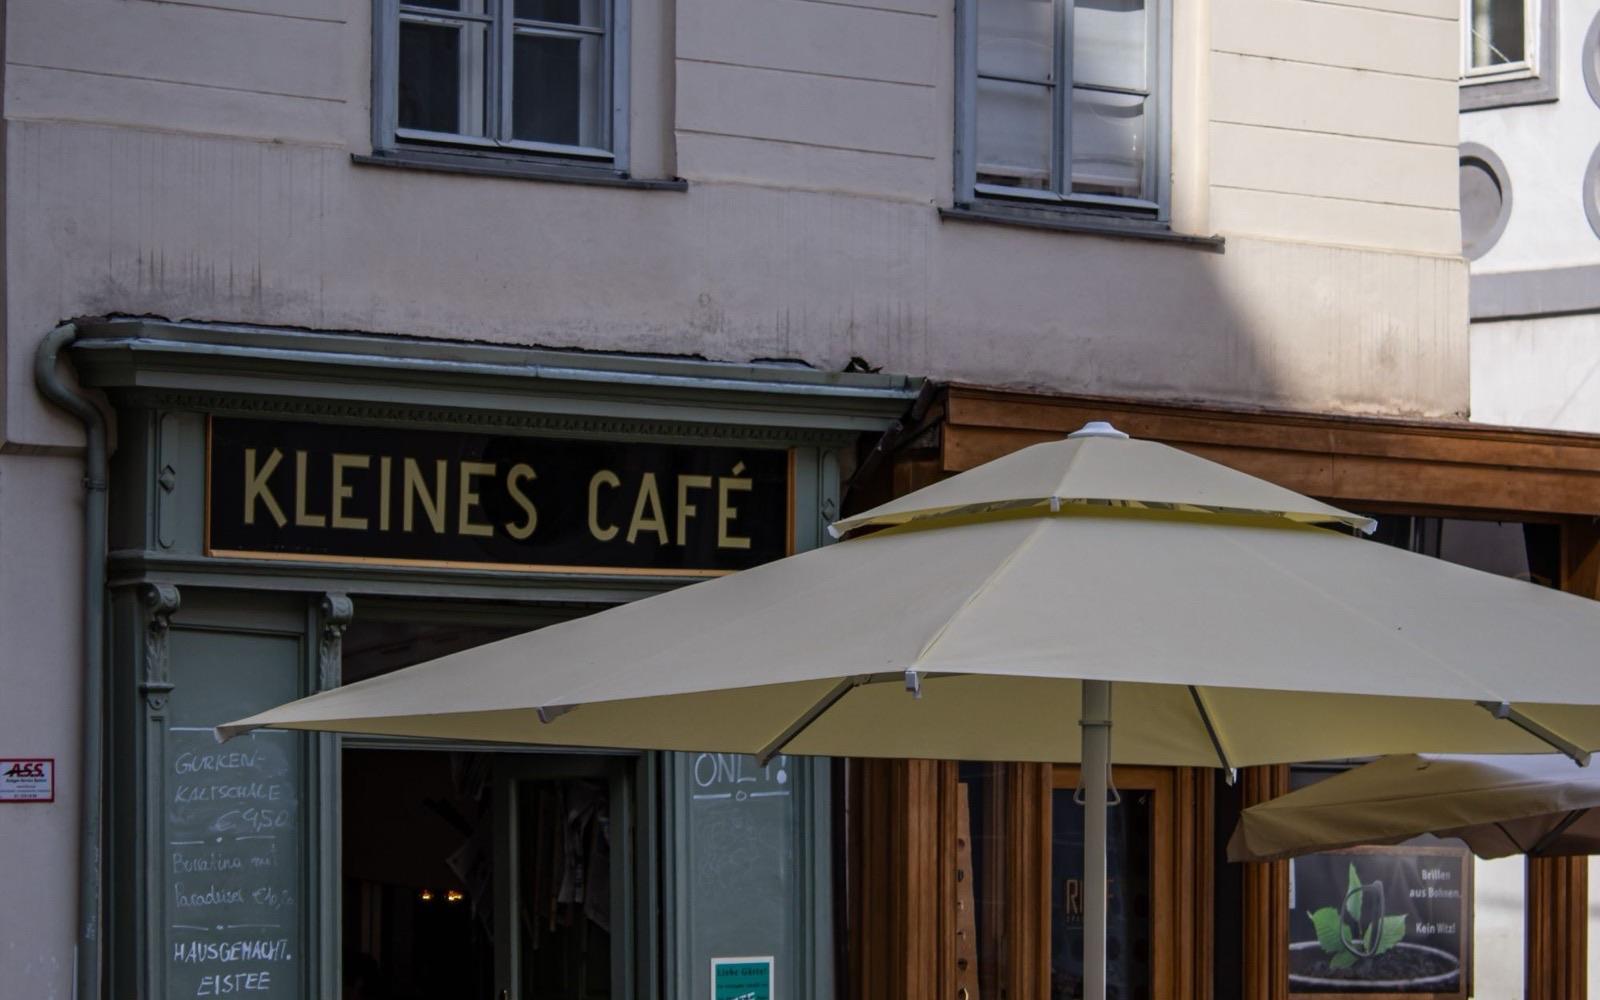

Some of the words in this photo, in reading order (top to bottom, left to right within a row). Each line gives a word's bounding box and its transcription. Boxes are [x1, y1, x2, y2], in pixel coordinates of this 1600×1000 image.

[244, 447, 538, 541] KLEINES
[588, 461, 753, 550] CAFÉ
[174, 783, 281, 803] KALTSCHALE
[1421, 868, 1451, 881] Brillen
[1409, 889, 1427, 898] aus
[1415, 922, 1435, 934] Kein
[197, 971, 271, 996] EISTEE
